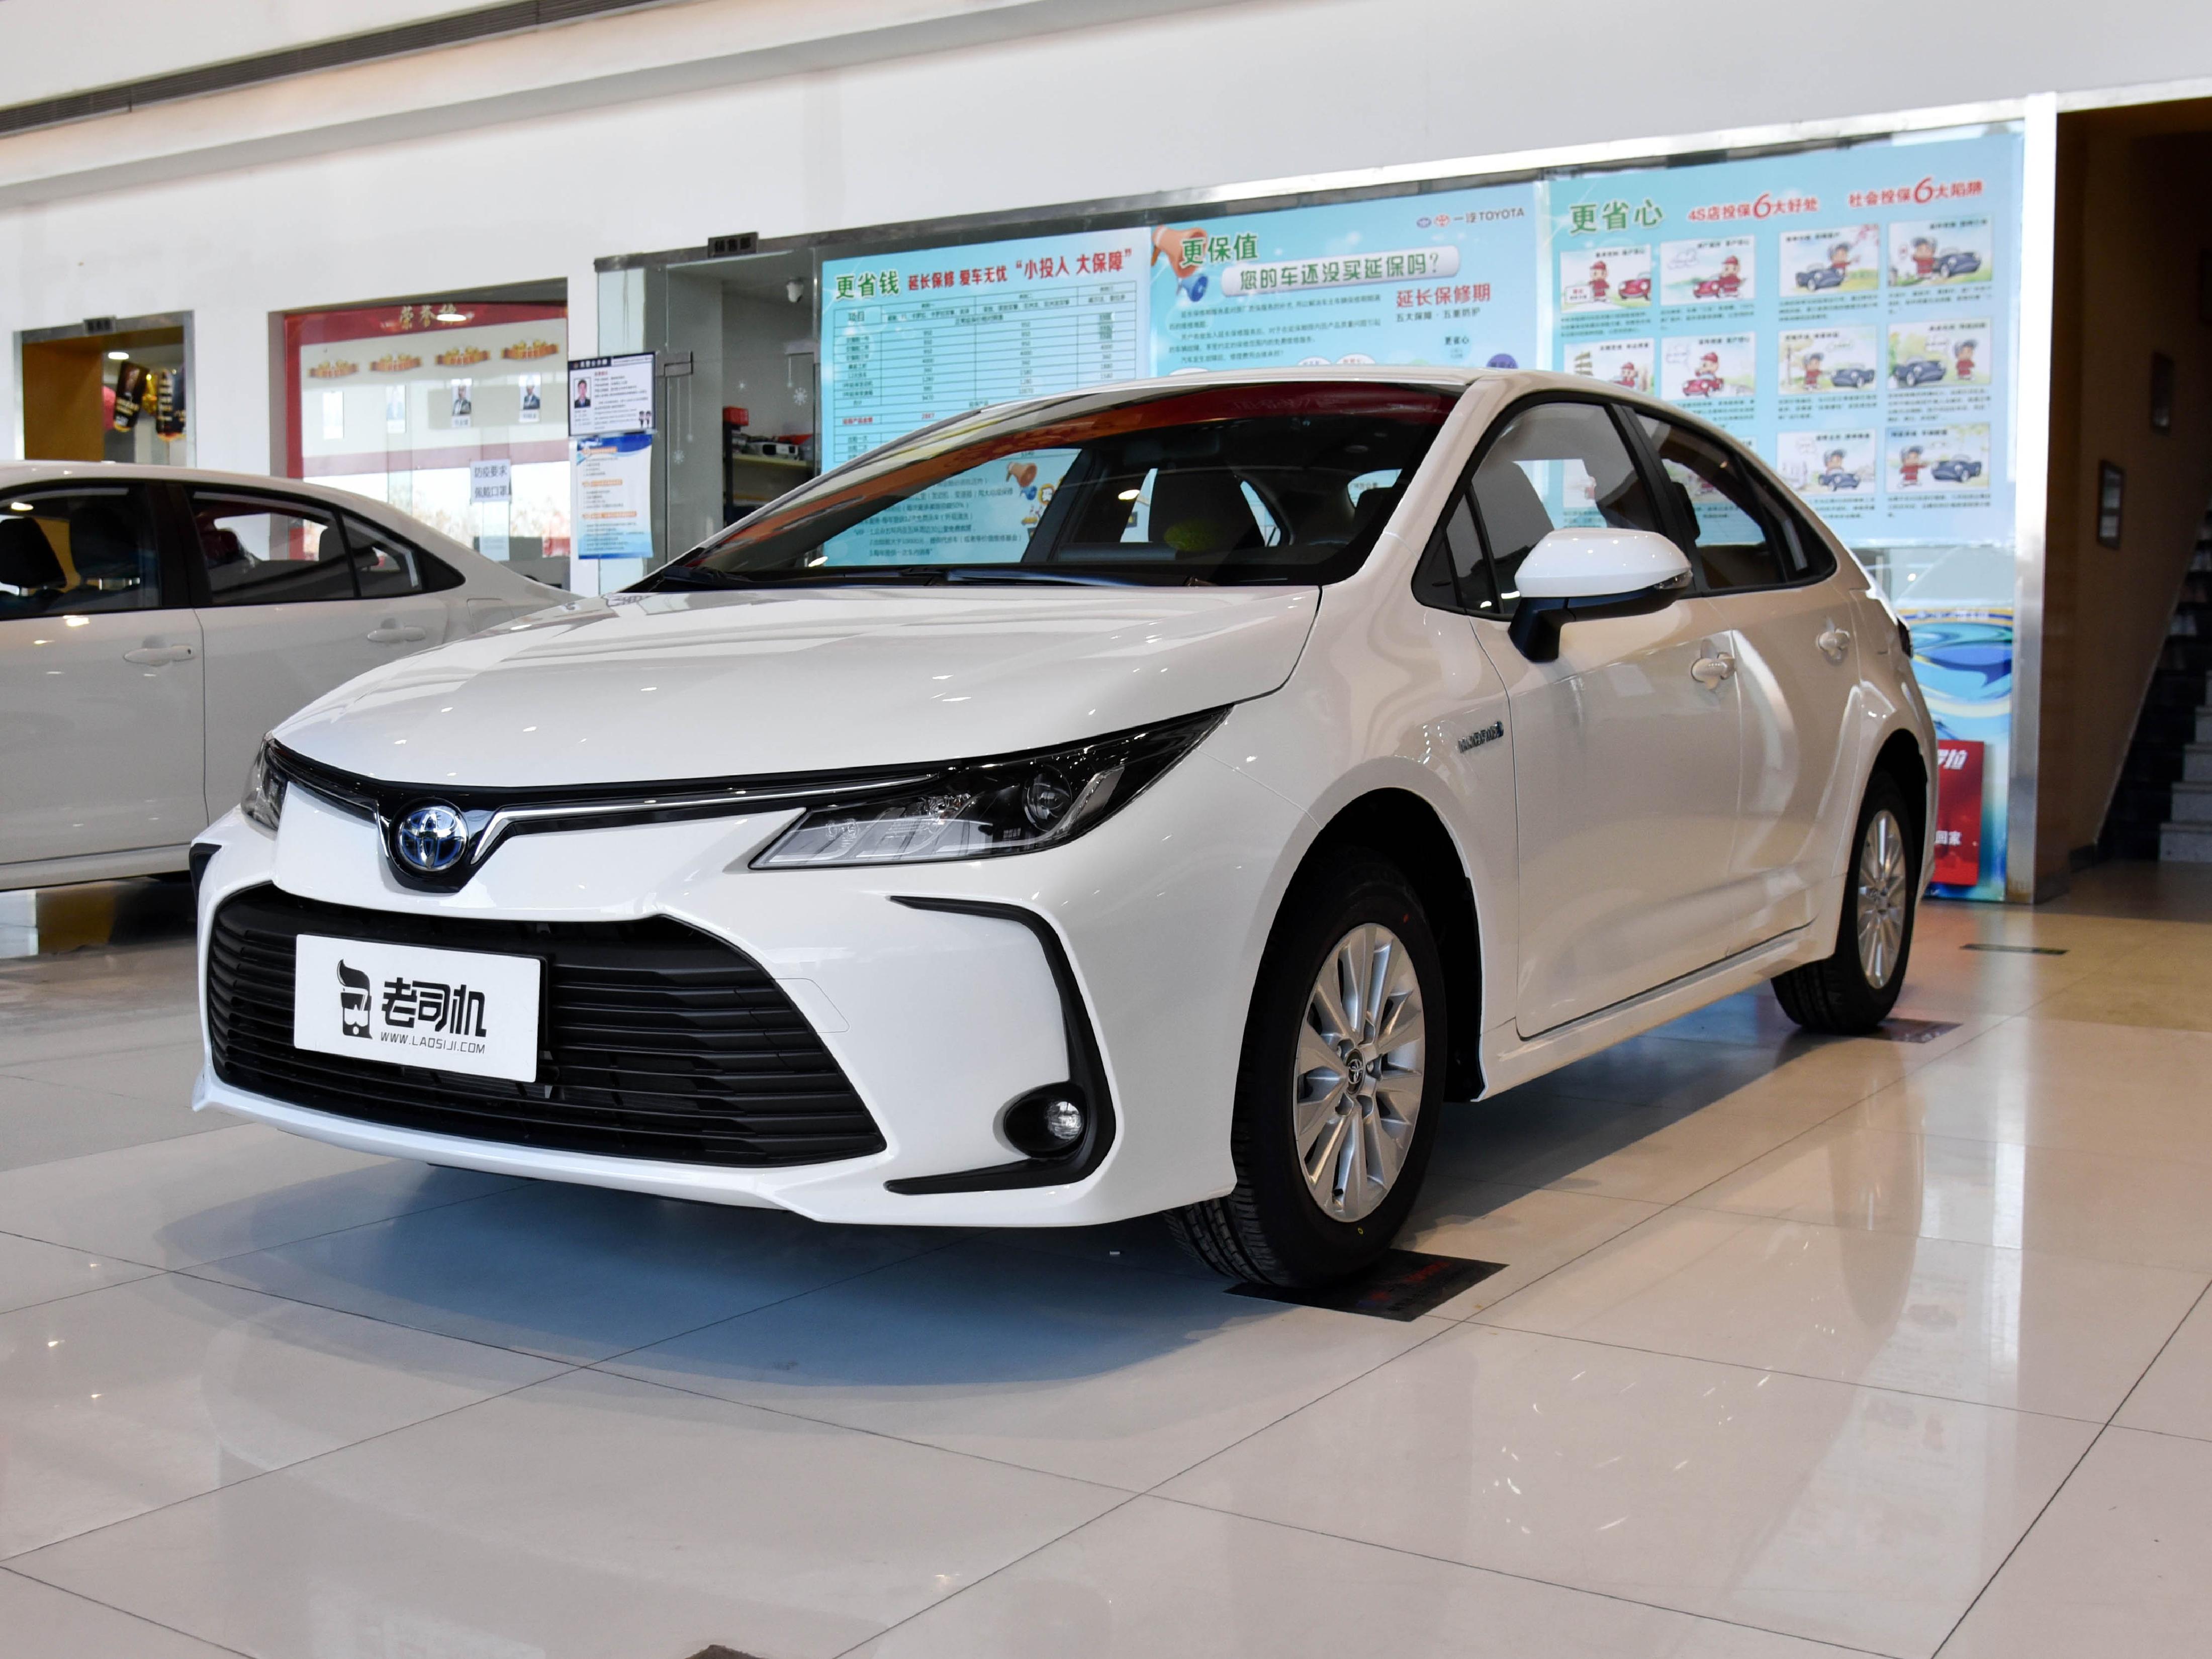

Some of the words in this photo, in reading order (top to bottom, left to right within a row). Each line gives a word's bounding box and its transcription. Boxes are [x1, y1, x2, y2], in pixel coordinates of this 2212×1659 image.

[1569, 200, 1664, 233] 更省心
[1687, 193, 1818, 221] 4S店投保6大好处
[1181, 233, 1258, 266] 更保值
[836, 270, 900, 299] 更省钱
[908, 270, 955, 291] 延长保修
[959, 265, 1007, 285] 爱车无忧
[1397, 283, 1491, 308] 延长保修期
[474, 466, 507, 478] 防疫要求
[475, 486, 507, 498] 佩戴口罩
[381, 977, 487, 1038] 老司机
[380, 1031, 486, 1055] WWW.LAOSIJI.COM
